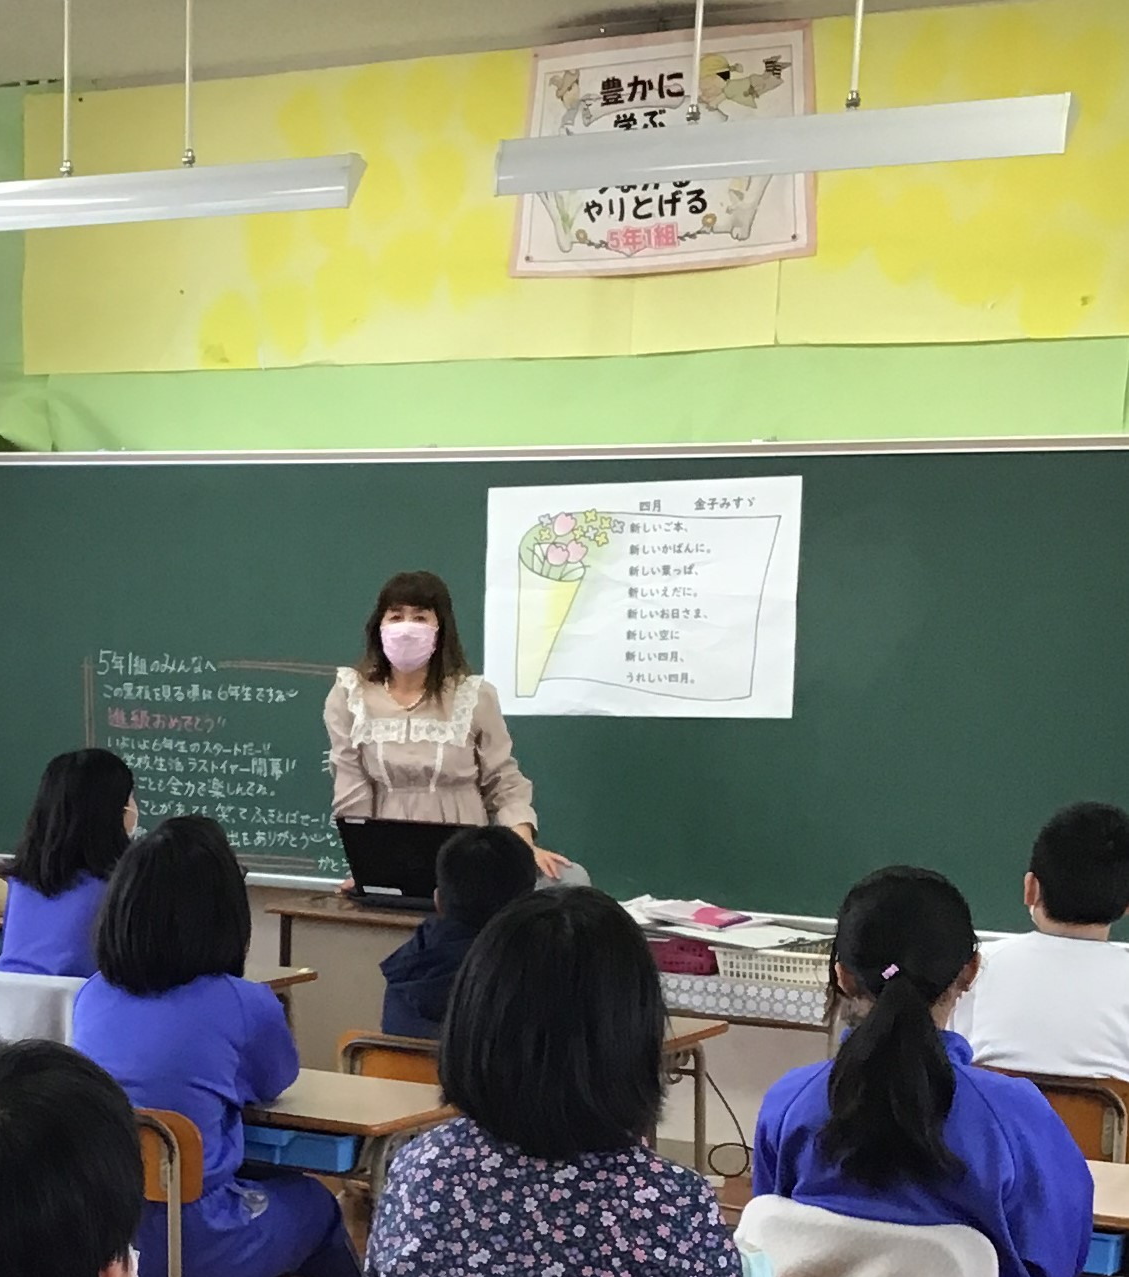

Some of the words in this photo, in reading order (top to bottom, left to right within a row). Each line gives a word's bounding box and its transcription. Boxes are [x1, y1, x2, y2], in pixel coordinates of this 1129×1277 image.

[599, 72, 685, 107] 豊かに
[584, 188, 708, 223] やりとげる
[608, 223, 678, 250] 5年1組
[639, 499, 661, 512] 四月
[625, 629, 681, 641] 新しい空に
[96, 649, 217, 676] 5年1組のみんなへ
[625, 672, 696, 684] うれしい四月。
